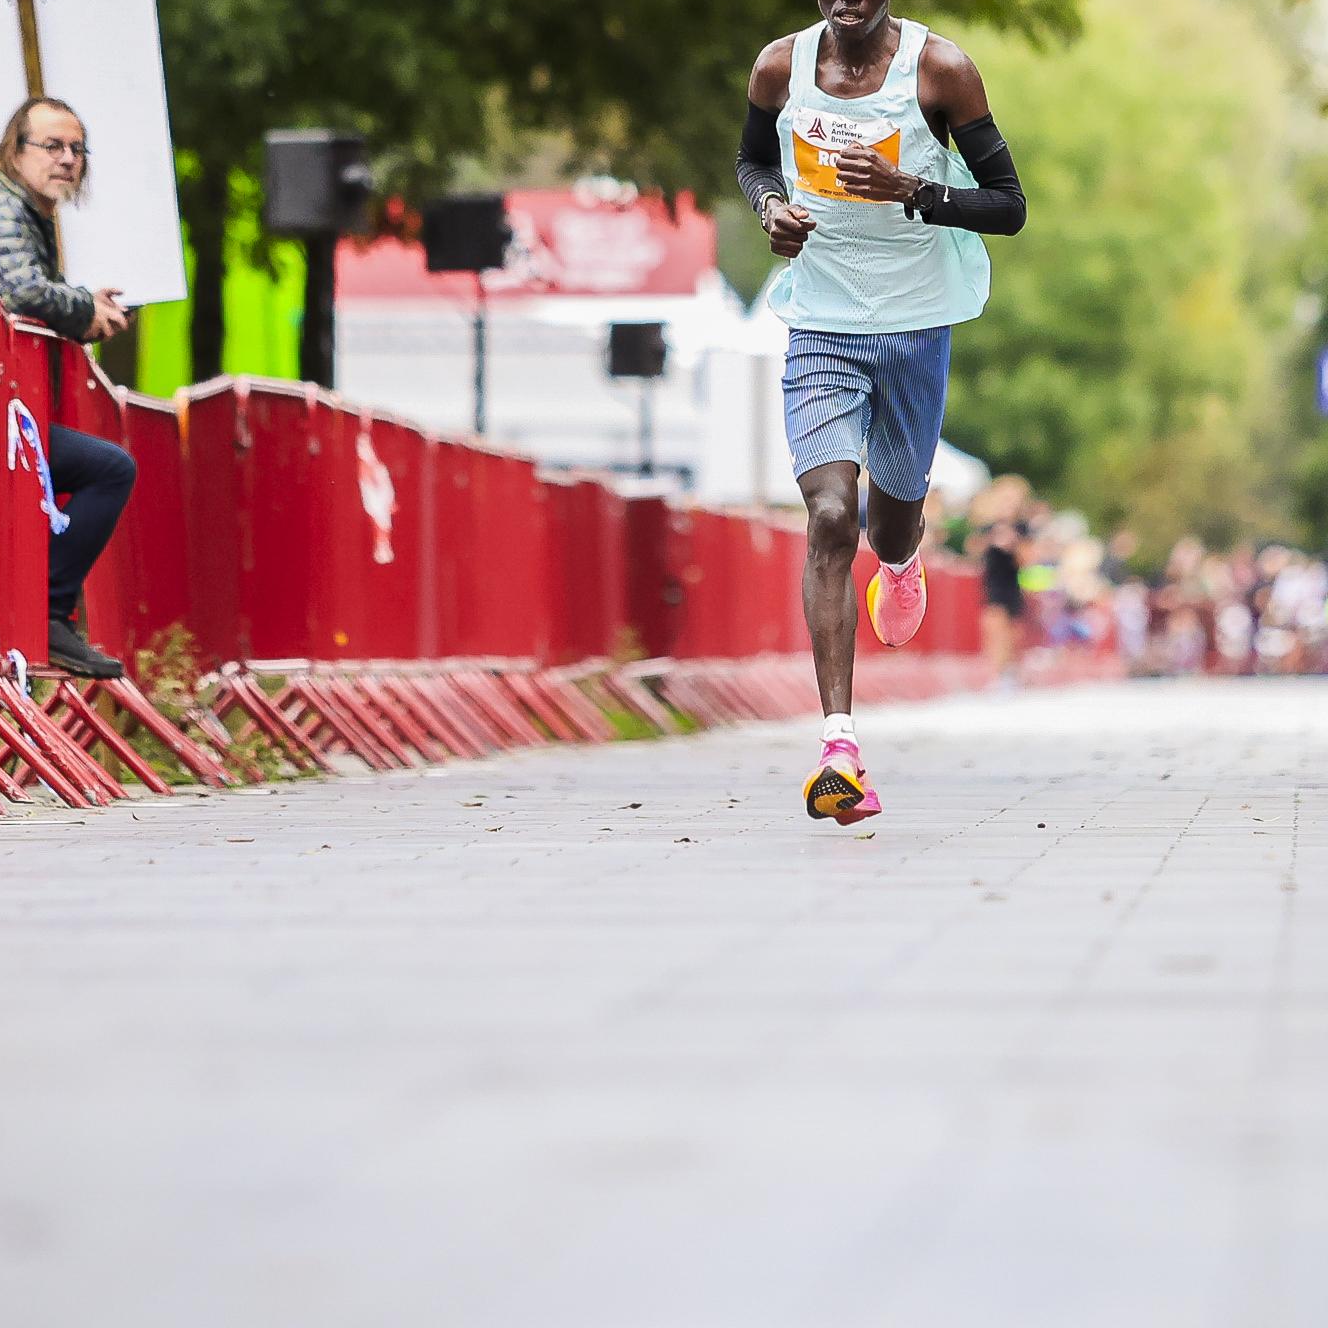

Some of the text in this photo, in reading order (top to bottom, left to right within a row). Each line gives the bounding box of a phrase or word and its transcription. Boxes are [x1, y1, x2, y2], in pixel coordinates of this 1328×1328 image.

[831, 121, 847, 129] Port
[831, 128, 863, 139] Antwerp
[831, 136, 853, 145] Bruge
